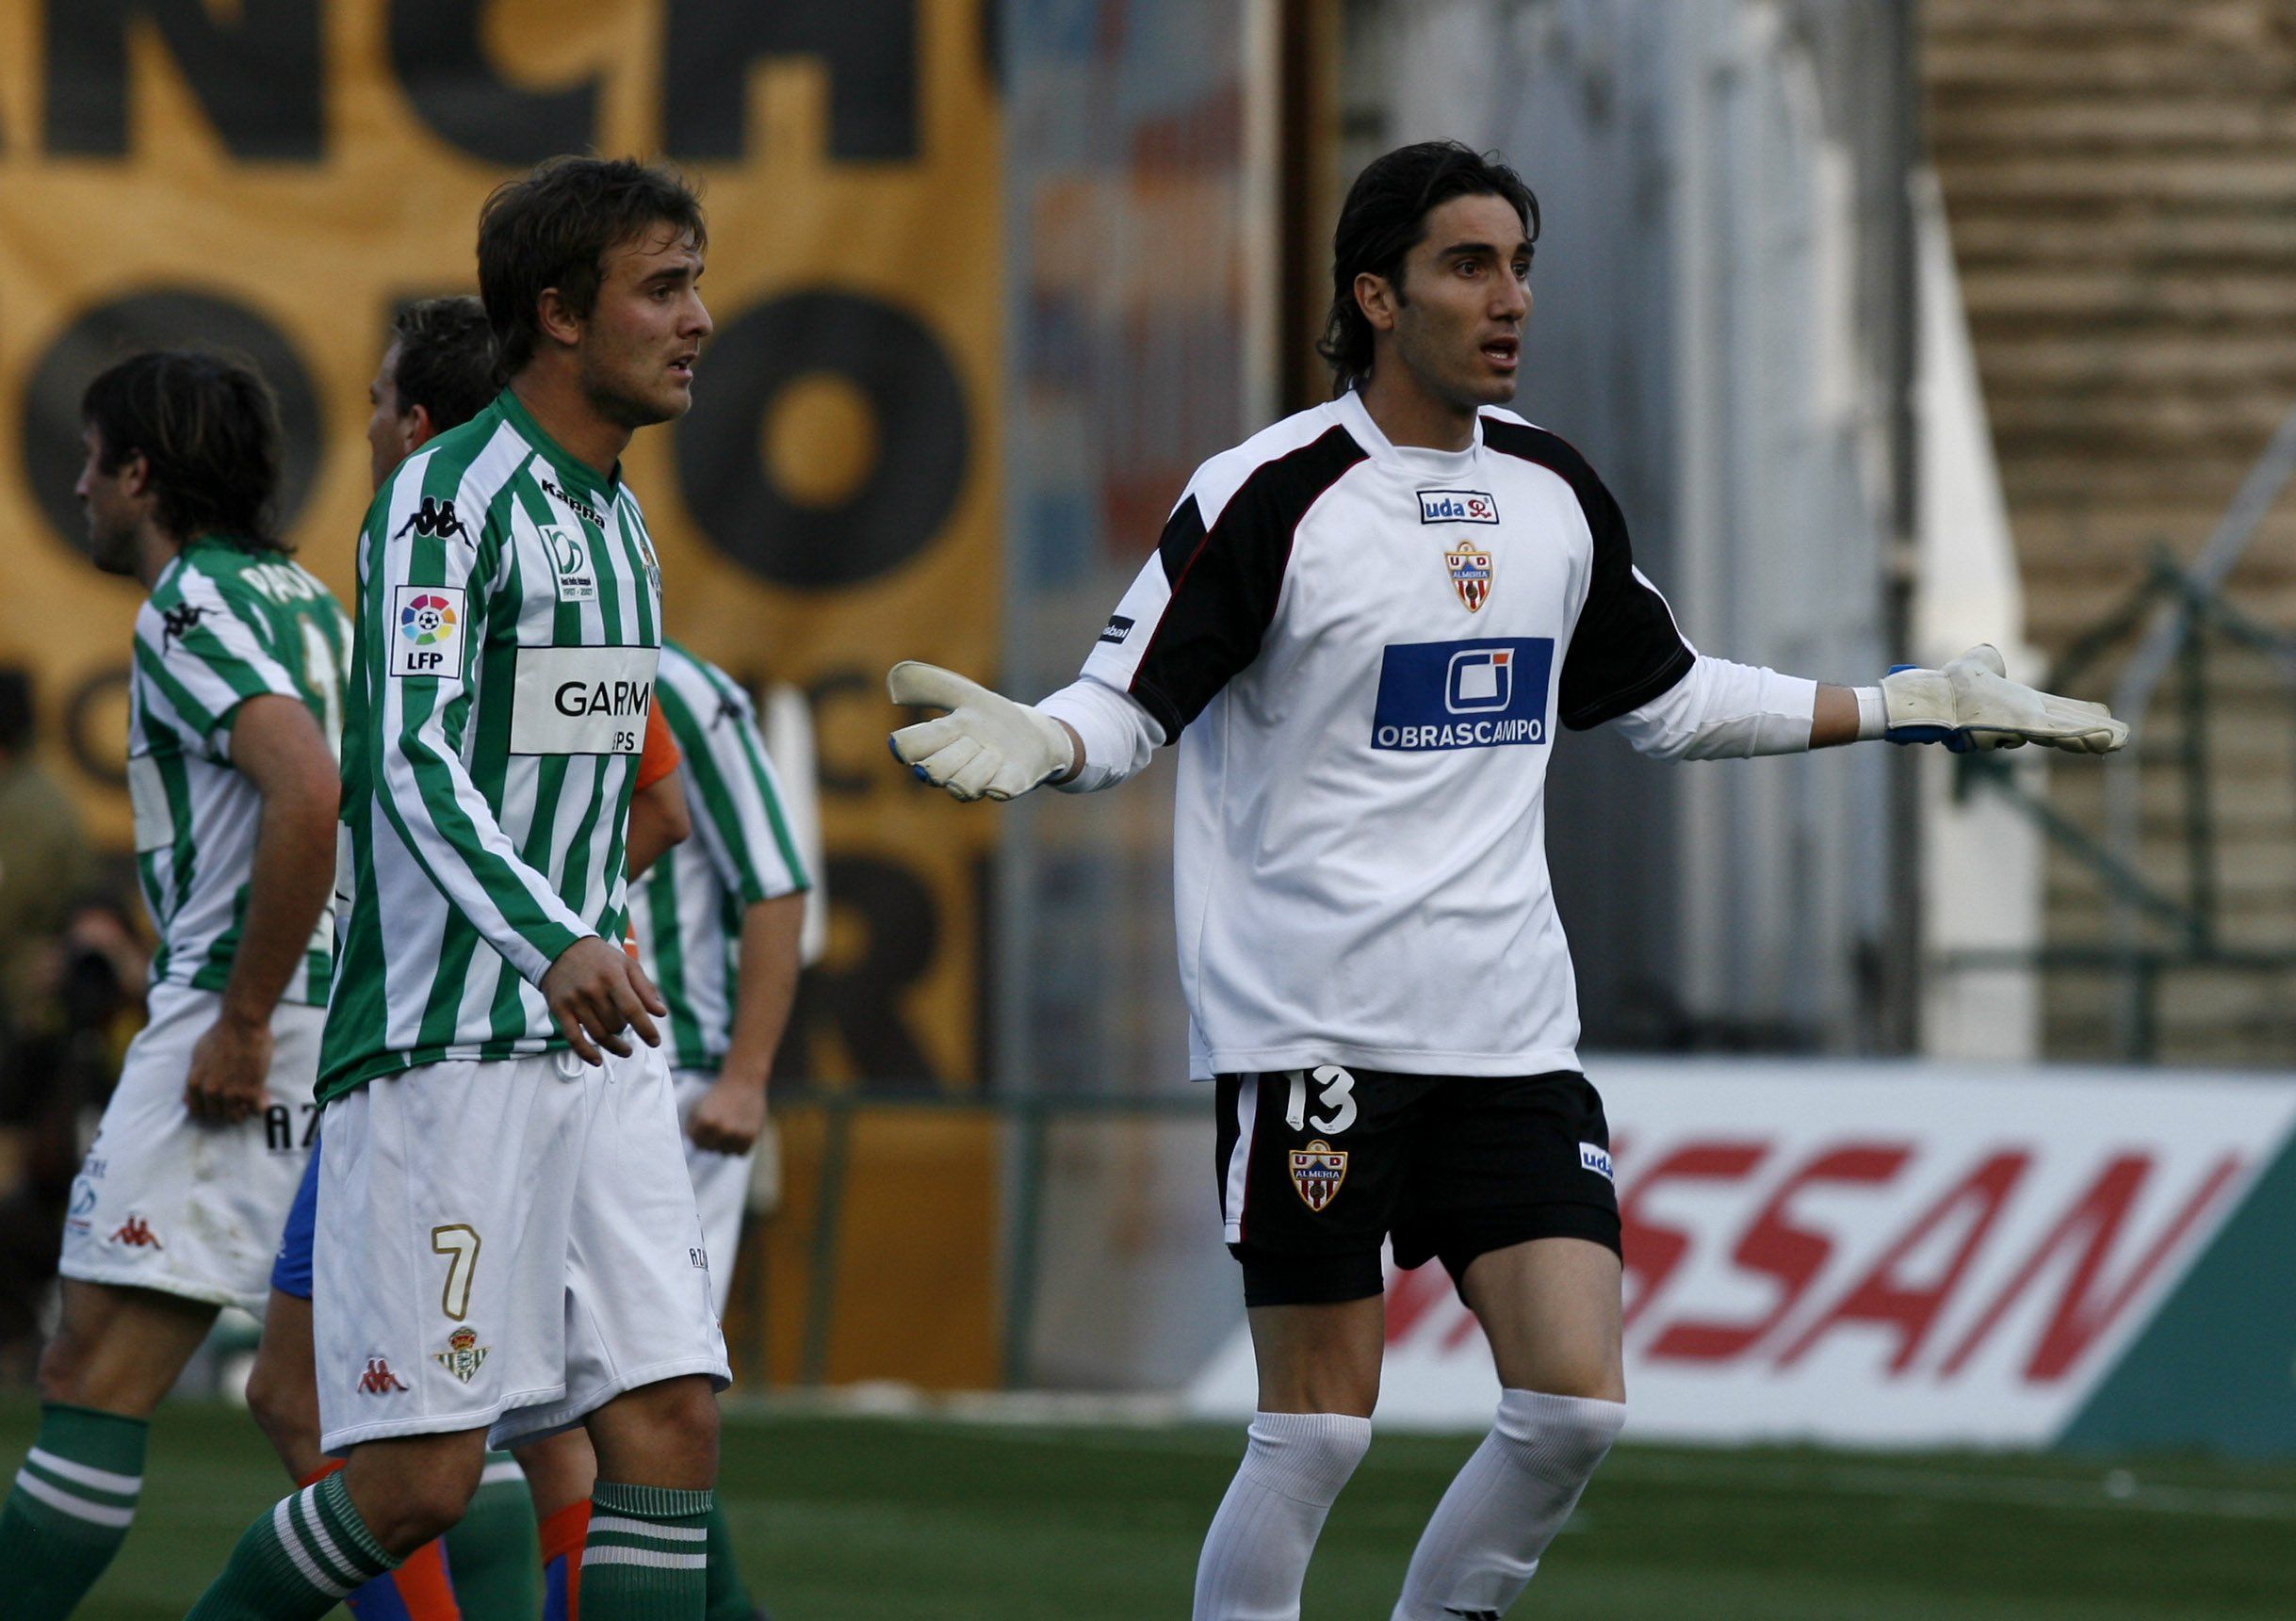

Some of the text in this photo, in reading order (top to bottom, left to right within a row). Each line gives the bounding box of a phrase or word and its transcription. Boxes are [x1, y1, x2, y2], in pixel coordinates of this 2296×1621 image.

[0, 0, 1004, 166] NCH
[542, 478, 606, 529] Kappa
[1425, 498, 1466, 518] uda
[407, 652, 444, 670] LFP
[554, 681, 654, 718] GARM
[611, 731, 635, 752] PS
[1377, 718, 1543, 748] OBRASCAMPO
[1285, 1064, 1359, 1136] 13
[1295, 1155, 1343, 1167] U D
[1295, 1169, 1341, 1179] ALMERIA
[432, 1223, 482, 1322] 7
[1383, 1138, 2248, 1383] SSAN
